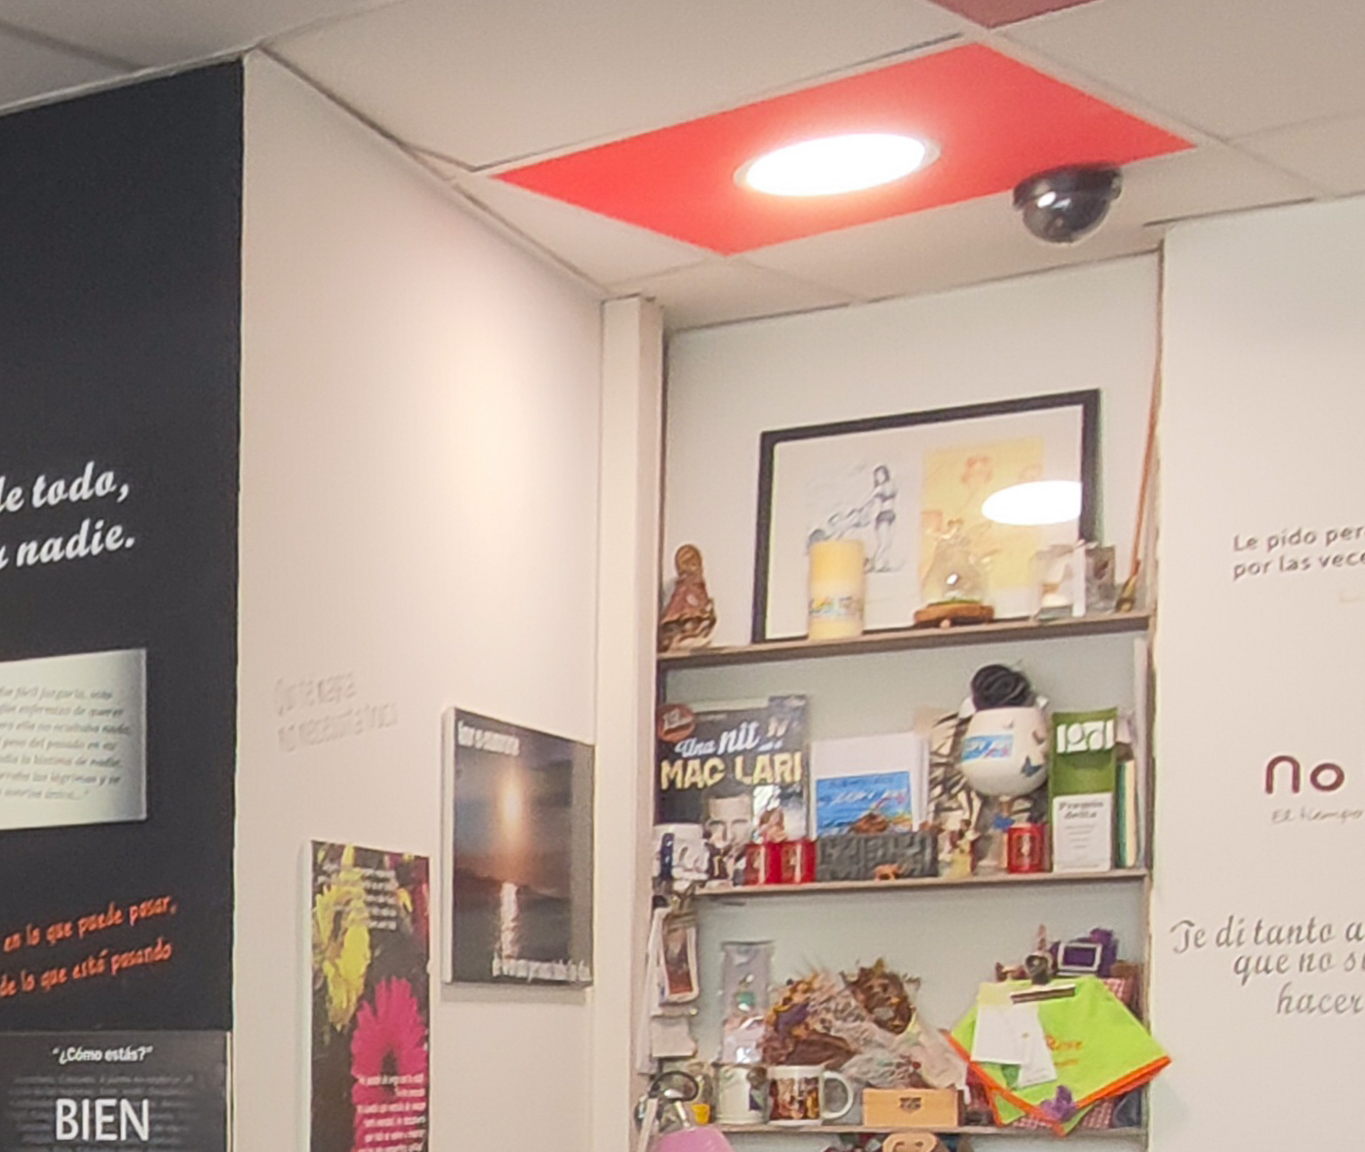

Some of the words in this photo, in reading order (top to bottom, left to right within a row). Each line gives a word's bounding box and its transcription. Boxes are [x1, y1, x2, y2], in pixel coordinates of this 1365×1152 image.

[31, 460, 130, 503] todo,
[15, 518, 135, 567] nadie.
[1233, 534, 1258, 552] Le
[1267, 527, 1317, 553] pido
[1325, 524, 1365, 547] per
[1233, 561, 1272, 580] por
[1279, 555, 1311, 572] las
[661, 757, 726, 790] MAG
[735, 752, 802, 785] LARI
[1265, 755, 1345, 795] no
[4, 932, 21, 952] en
[26, 924, 40, 946] lo
[46, 918, 73, 948] que
[78, 901, 123, 935] puede
[1170, 919, 1207, 955] Te
[1215, 914, 1247, 948] di
[1253, 917, 1334, 945] tanto
[0, 975, 17, 997] de
[21, 970, 35, 993] lo
[41, 964, 67, 992] que
[110, 939, 172, 977] pasando
[1233, 953, 1290, 986] que
[1298, 950, 1335, 975] no
[55, 1098, 149, 1141] BIEN
